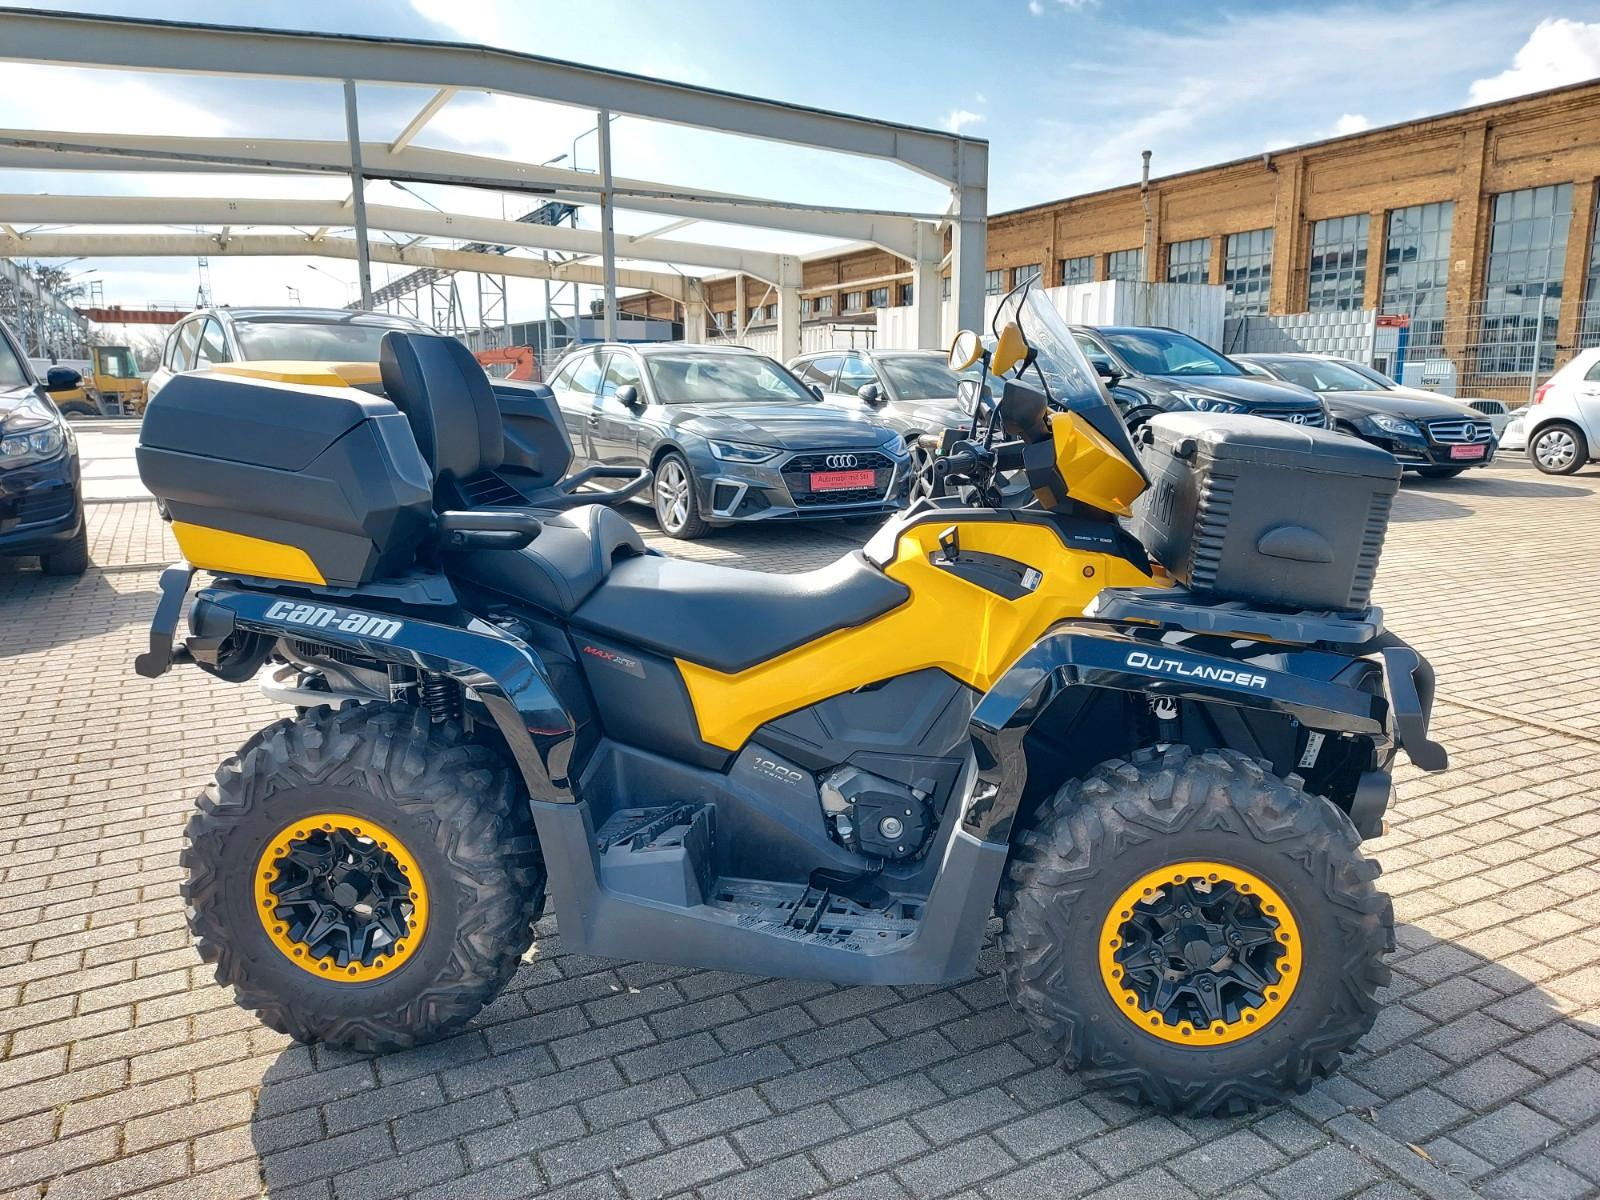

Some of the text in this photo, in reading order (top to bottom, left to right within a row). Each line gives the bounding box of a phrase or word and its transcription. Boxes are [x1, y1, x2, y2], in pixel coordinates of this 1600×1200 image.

[265, 601, 402, 639] can-am
[583, 646, 615, 660] MAX
[754, 757, 802, 781] 1000
